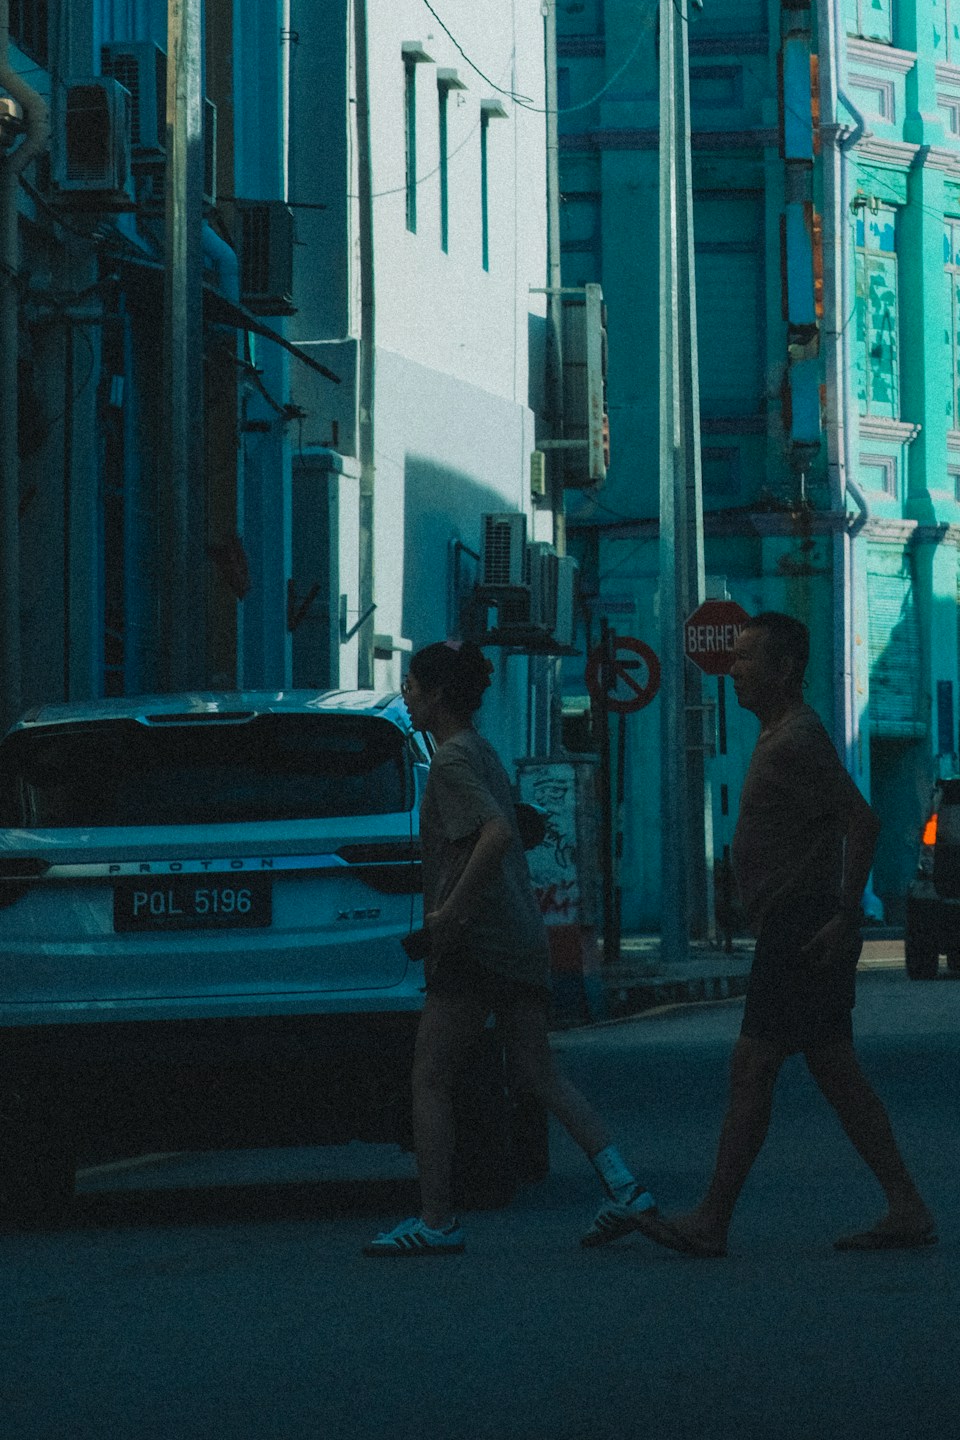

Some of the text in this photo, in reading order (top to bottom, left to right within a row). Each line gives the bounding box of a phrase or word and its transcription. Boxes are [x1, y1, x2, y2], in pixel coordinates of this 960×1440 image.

[108, 858, 274, 874] PROTON
[132, 887, 252, 917] PQL 5196
